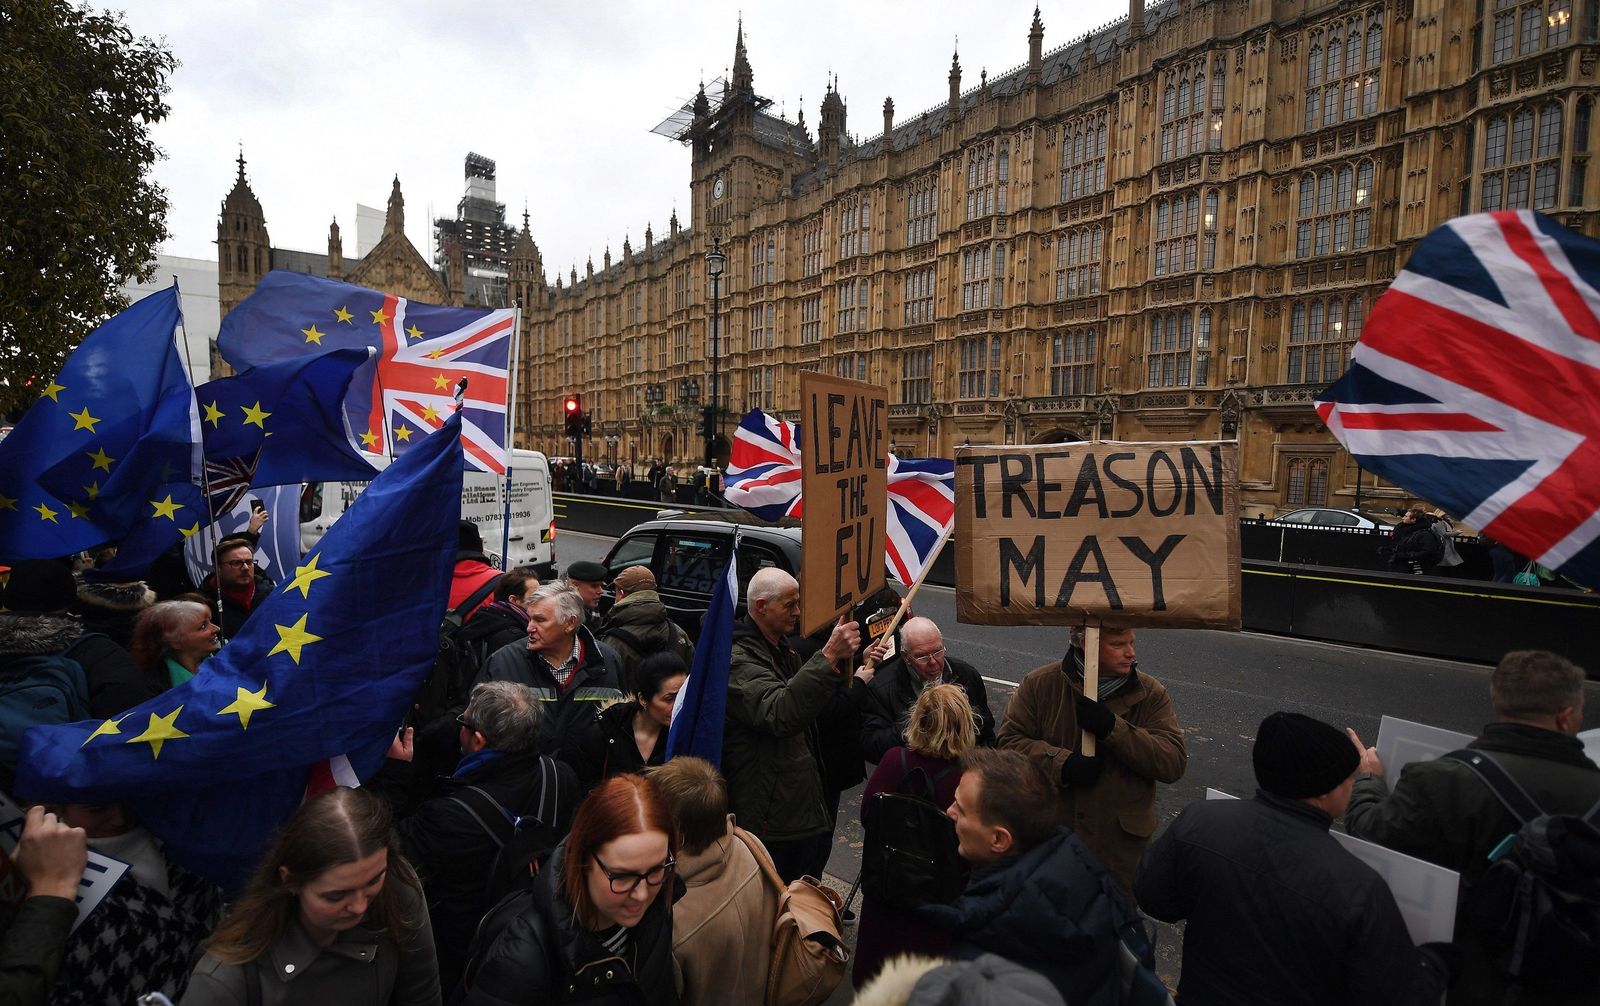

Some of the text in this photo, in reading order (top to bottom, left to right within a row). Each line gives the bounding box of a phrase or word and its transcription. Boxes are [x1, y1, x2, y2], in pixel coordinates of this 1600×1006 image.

[812, 393, 885, 474] LEAVE
[836, 475, 868, 524] THE
[956, 445, 1224, 520] TREASON
[527, 543, 536, 551] GB
[834, 517, 875, 610] EU
[1000, 534, 1187, 612] MAY
